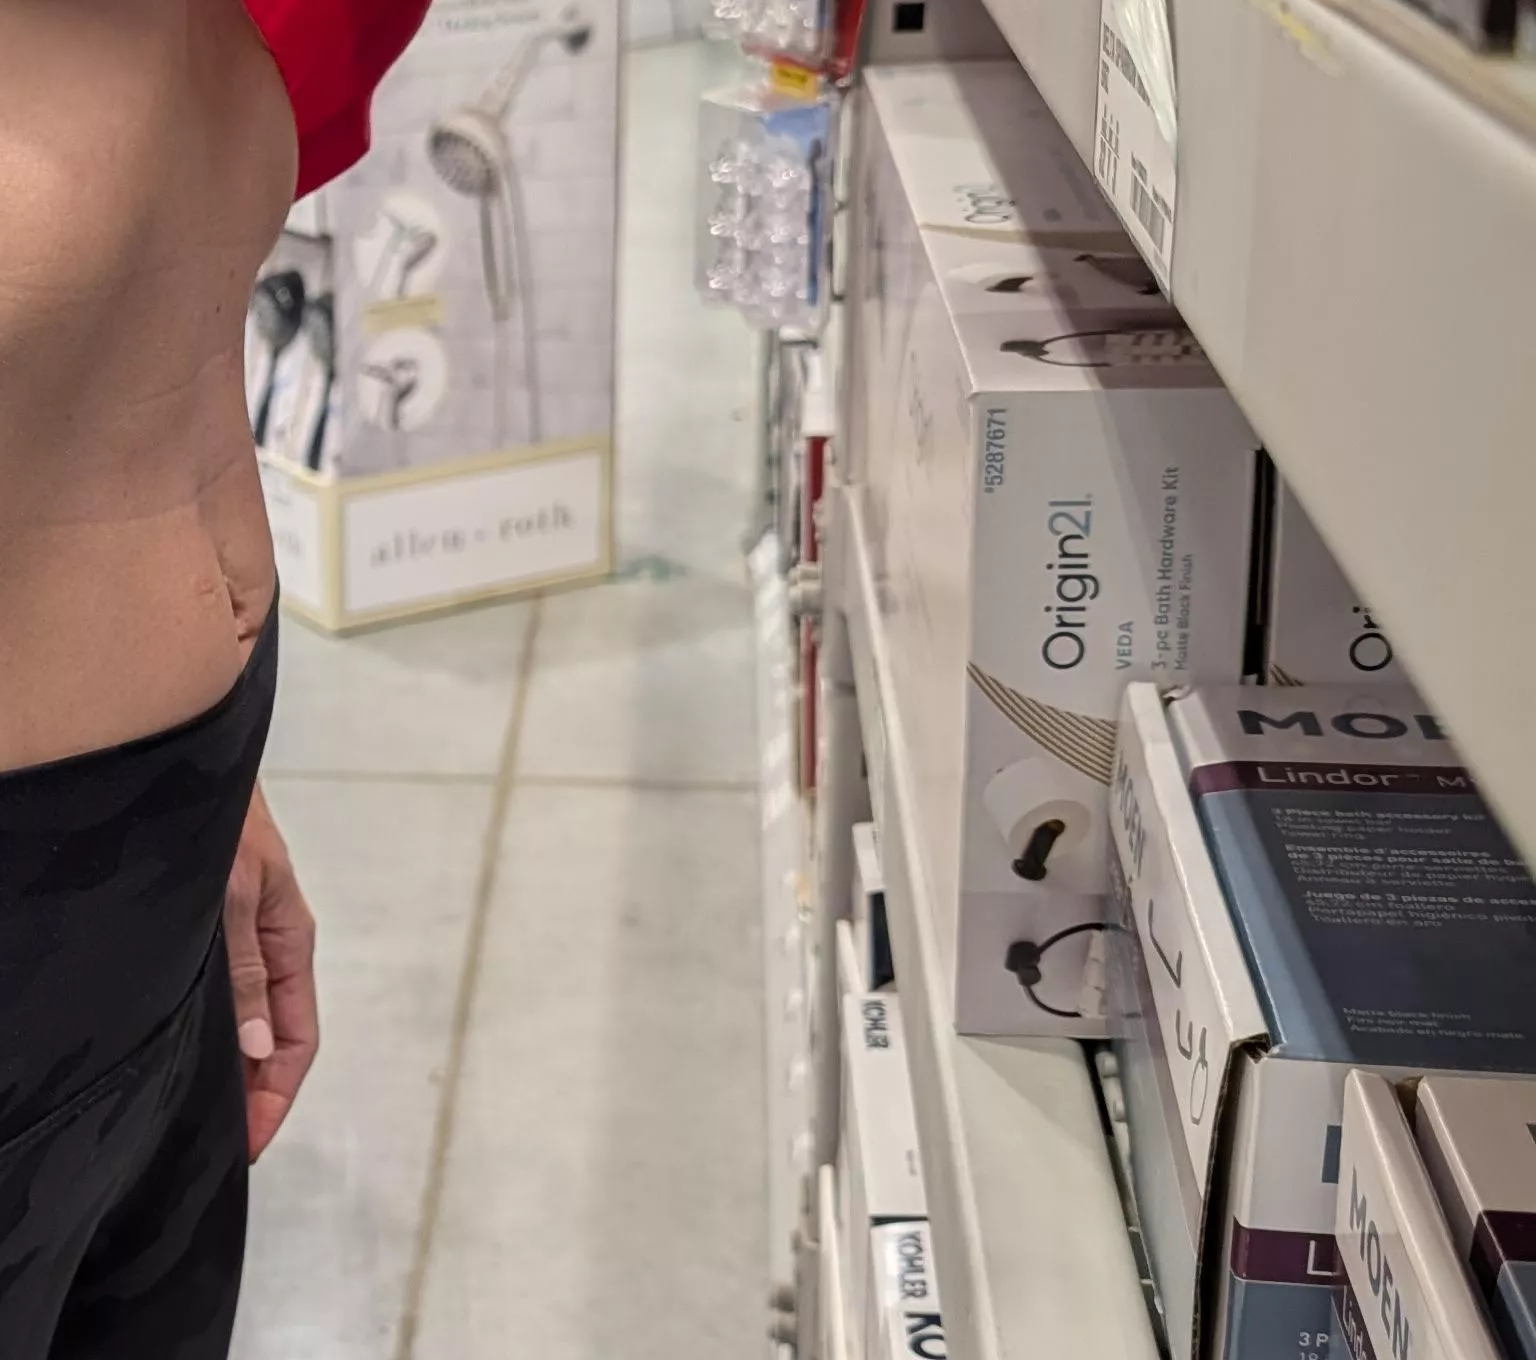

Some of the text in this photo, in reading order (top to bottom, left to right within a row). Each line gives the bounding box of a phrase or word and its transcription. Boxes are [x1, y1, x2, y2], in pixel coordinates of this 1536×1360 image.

[1162, 465, 1180, 490] Kit
[1157, 495, 1178, 581] Hardware
[1155, 584, 1172, 626] Bath
[1174, 553, 1194, 671] Matte Black Finish
[1115, 620, 1135, 671] VEDA
[896, 1230, 930, 1300] KOHLER
[1299, 1331, 1312, 1348] 3
